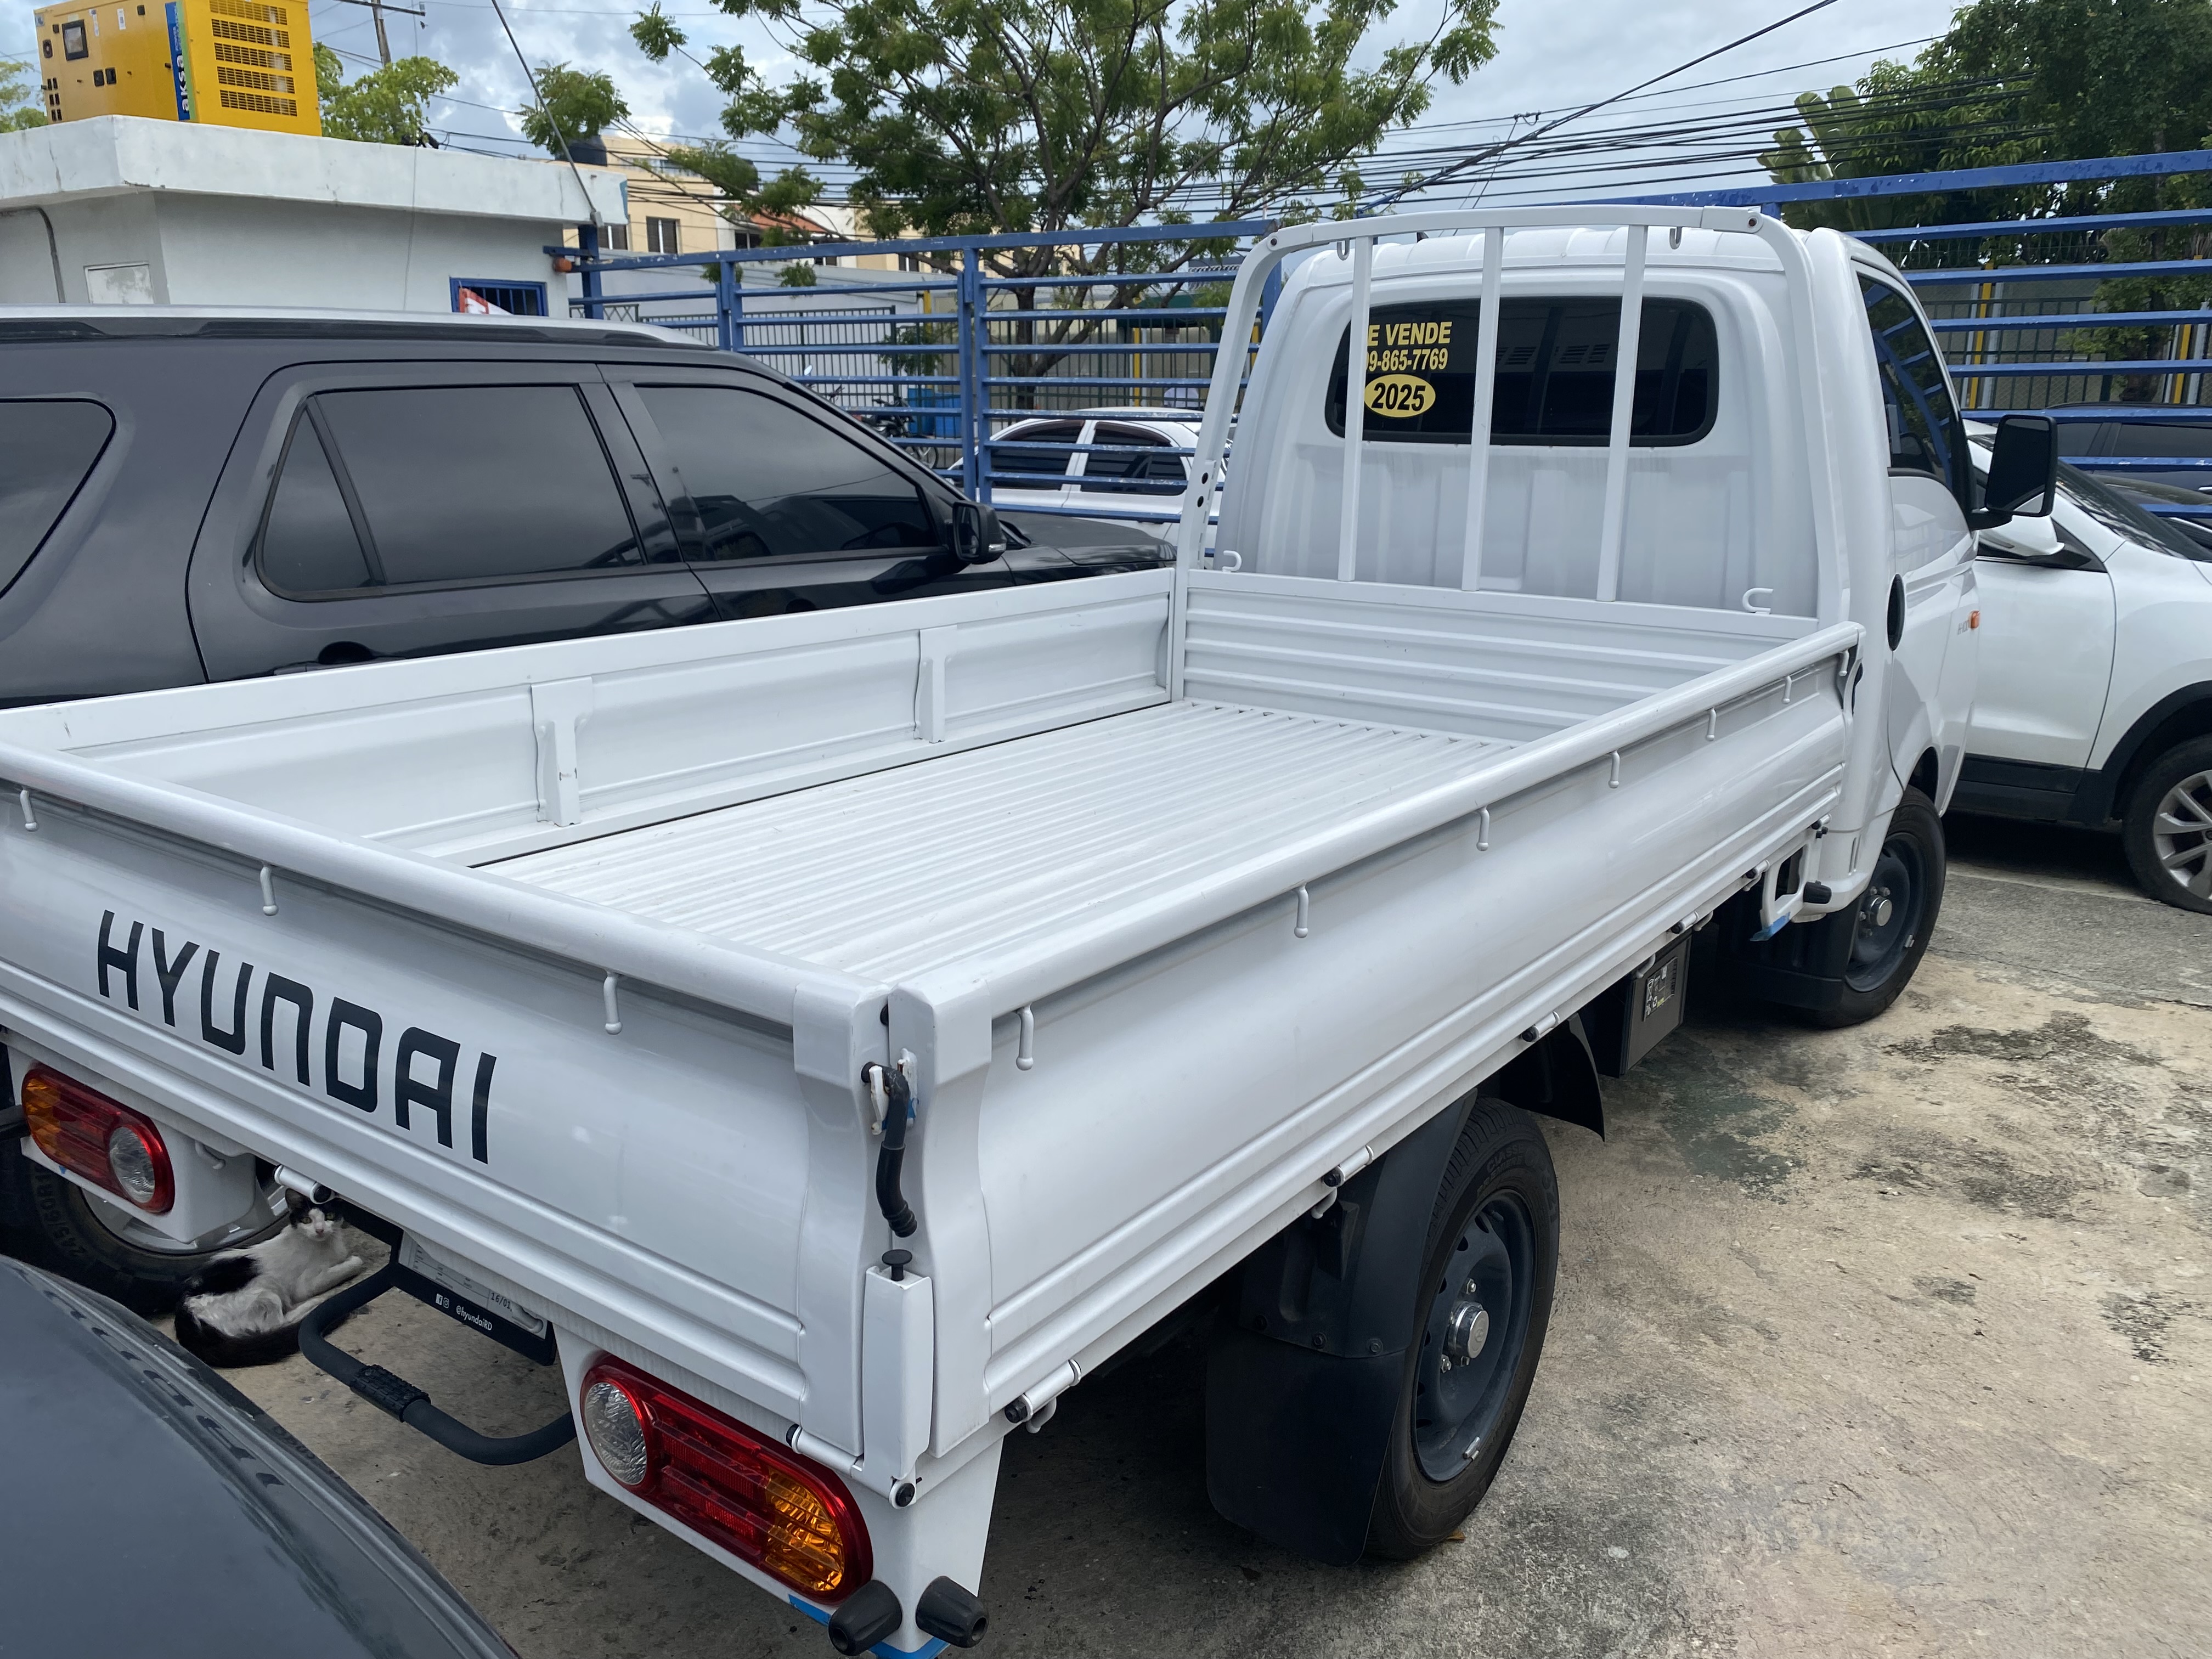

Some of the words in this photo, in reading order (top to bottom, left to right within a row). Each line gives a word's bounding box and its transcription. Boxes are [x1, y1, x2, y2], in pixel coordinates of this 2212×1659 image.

[177, 55, 189, 111] aksa
[1367, 324, 1380, 346] E
[1385, 321, 1453, 346] VENDE
[1366, 348, 1448, 371] 9-865-7769
[1371, 382, 1426, 411] 2025
[97, 909, 497, 1165] HYUNDAI
[490, 1292, 512, 1312] 16/01
[456, 1305, 493, 1331] @hyundaiRD
